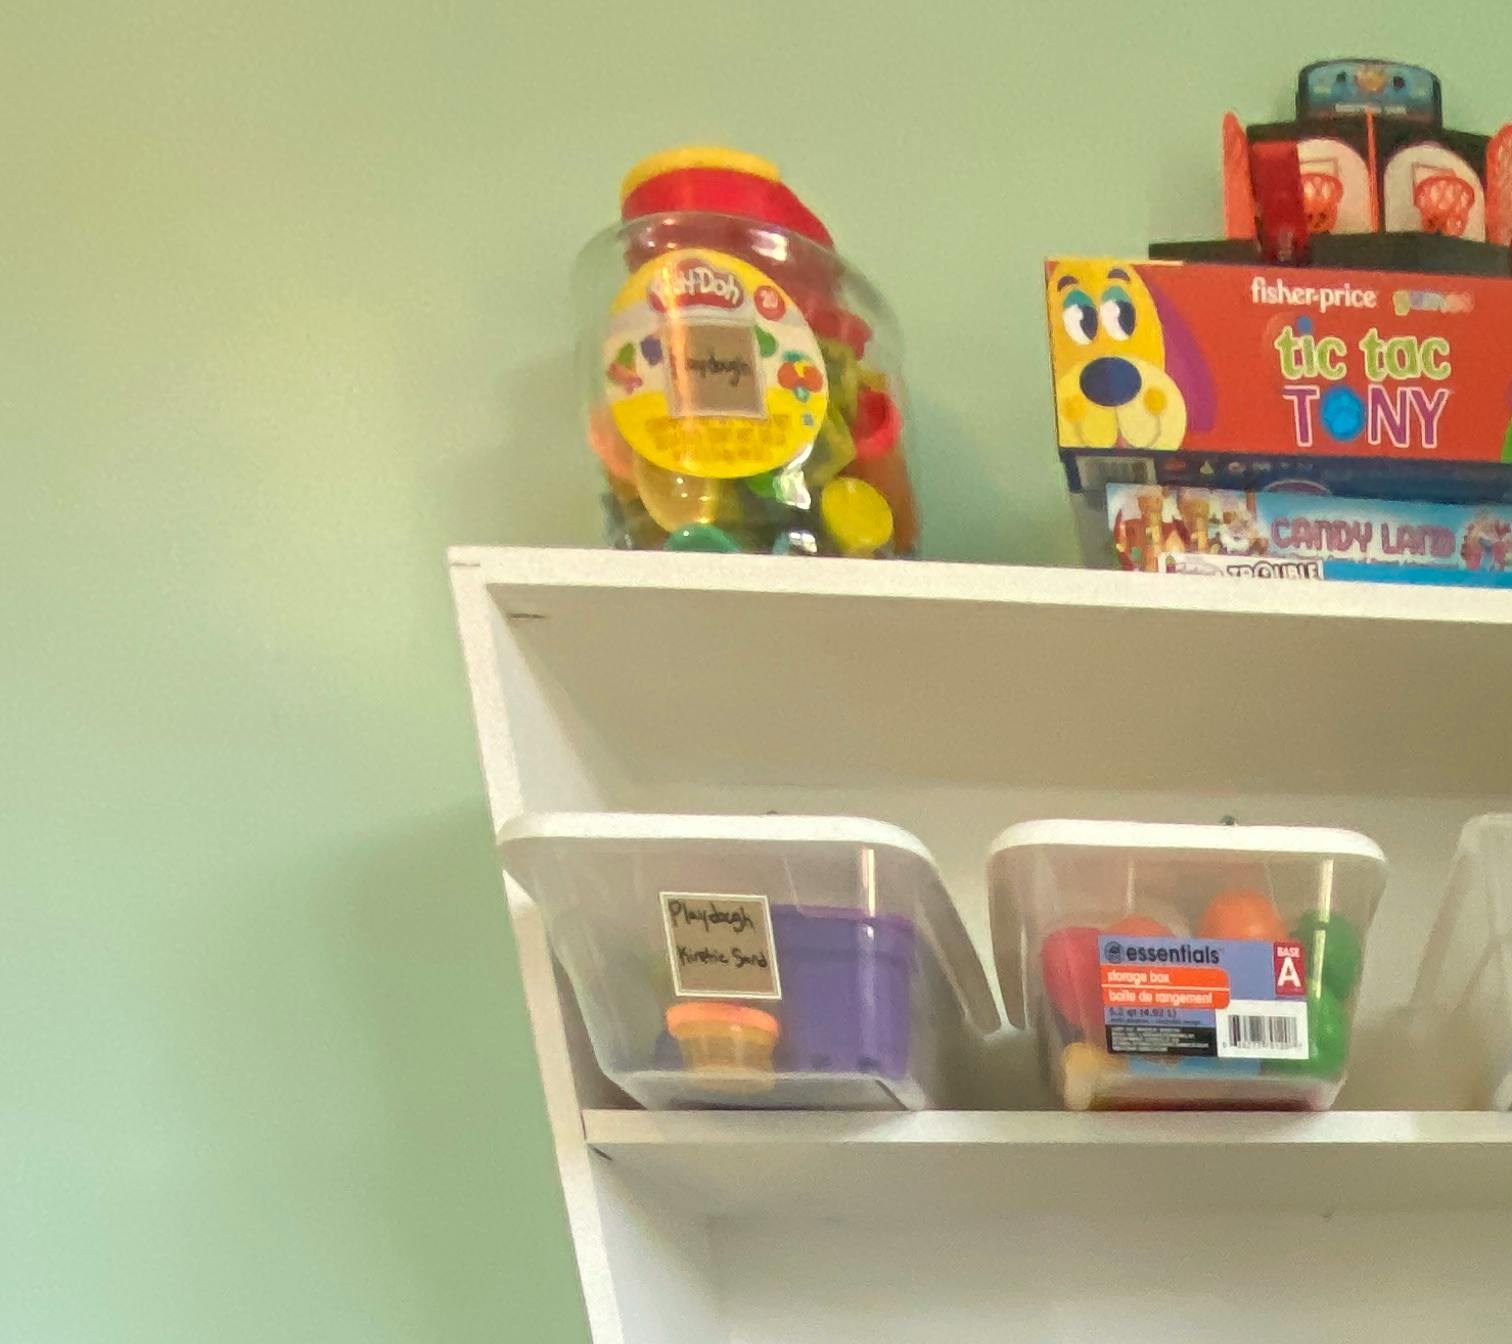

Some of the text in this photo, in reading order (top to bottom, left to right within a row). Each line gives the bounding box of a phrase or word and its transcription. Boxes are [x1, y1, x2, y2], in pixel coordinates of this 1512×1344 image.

[1251, 276, 1377, 313] fisher-price
[1274, 325, 1452, 382] tic tac
[1283, 383, 1450, 448] TONY
[1271, 517, 1457, 558] CANDY LAND
[1126, 943, 1220, 964] essentials
[1276, 946, 1300, 958] BASE
[1107, 970, 1170, 987] storage box
[1277, 956, 1302, 988] A
[1138, 990, 1153, 1002] de
[1155, 991, 1213, 1006] rangement
